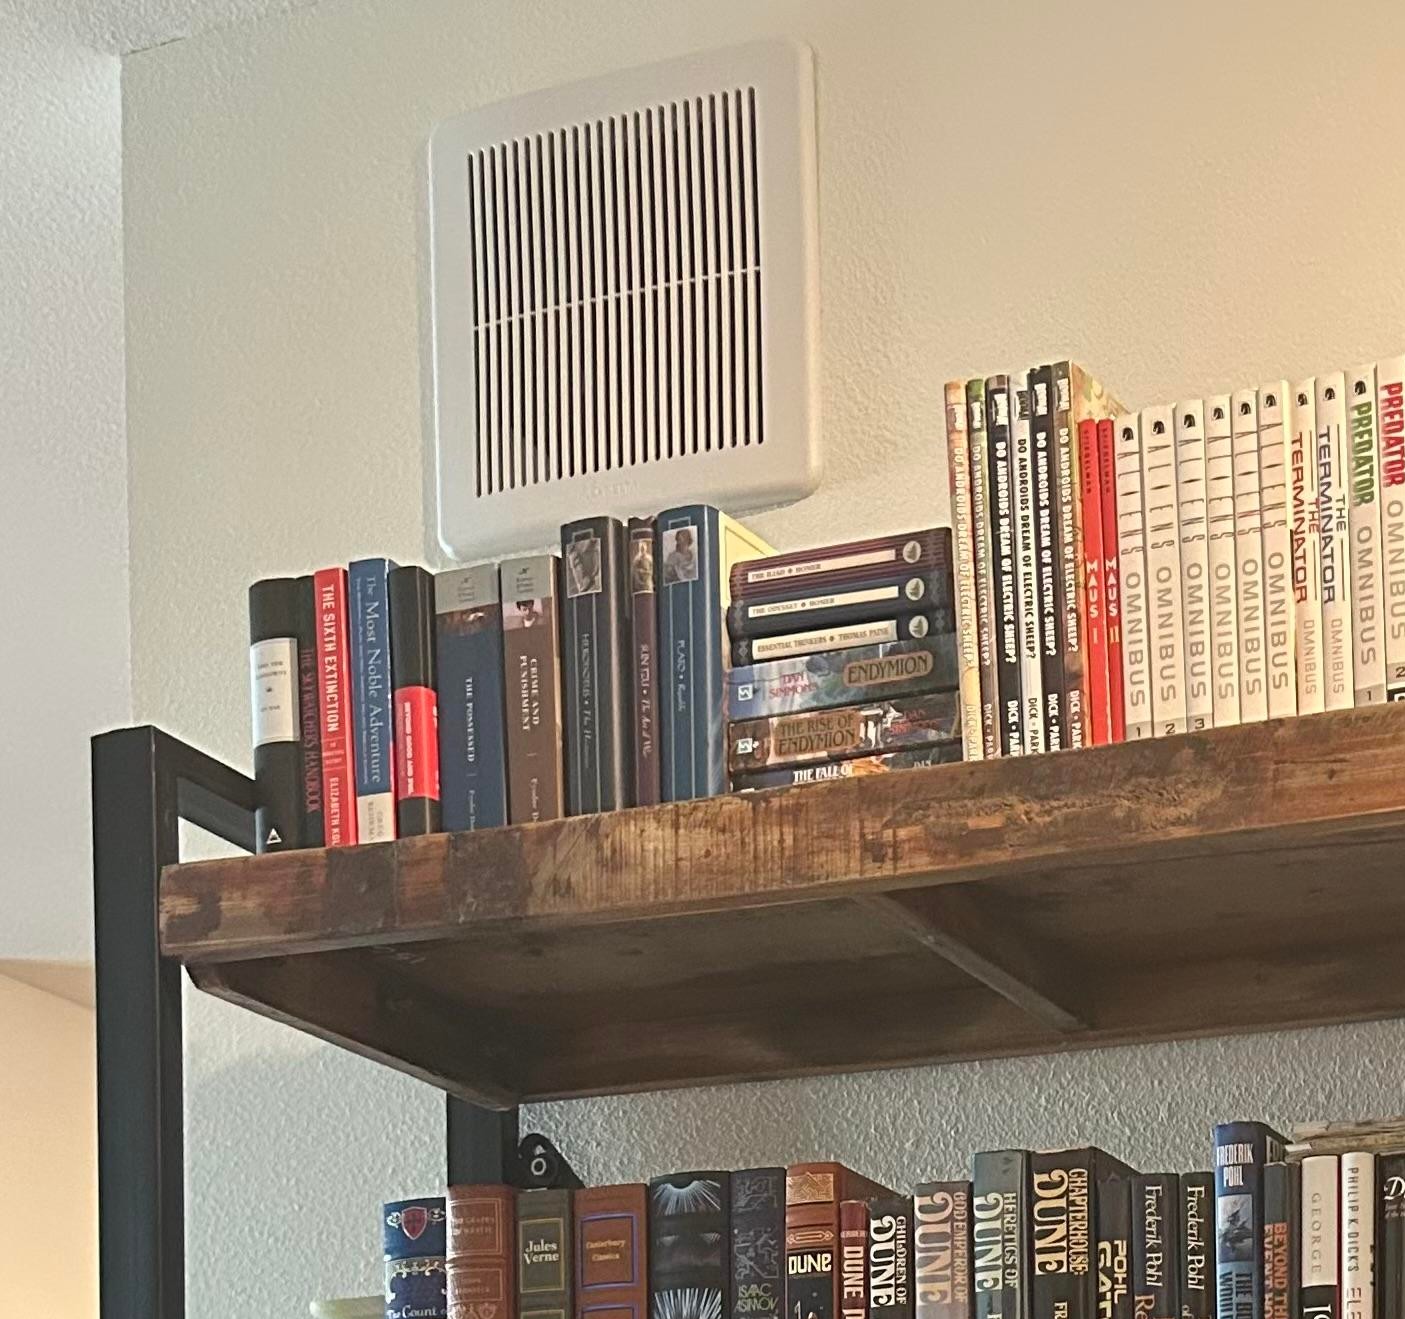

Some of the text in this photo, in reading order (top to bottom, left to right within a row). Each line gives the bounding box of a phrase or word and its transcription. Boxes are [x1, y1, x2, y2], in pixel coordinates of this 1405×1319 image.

[1380, 383, 1405, 488] PREDATOR
[1320, 426, 1335, 604] TERMINATOR
[1350, 402, 1376, 665] PREDATOR OMNIBUS
[1086, 561, 1098, 619] MAUS
[1125, 573, 1146, 706] OMNIBUS
[321, 584, 340, 733] THE SIXTH EXTINCTION
[366, 577, 381, 784] The Most Noble Adventure
[847, 655, 929, 684] ENDYMION
[1135, 727, 1141, 736] 1
[524, 1251, 559, 1264] Verne
[526, 1240, 558, 1254] Jules
[844, 1246, 863, 1299] DUNE
[915, 1192, 953, 1305] DUNE
